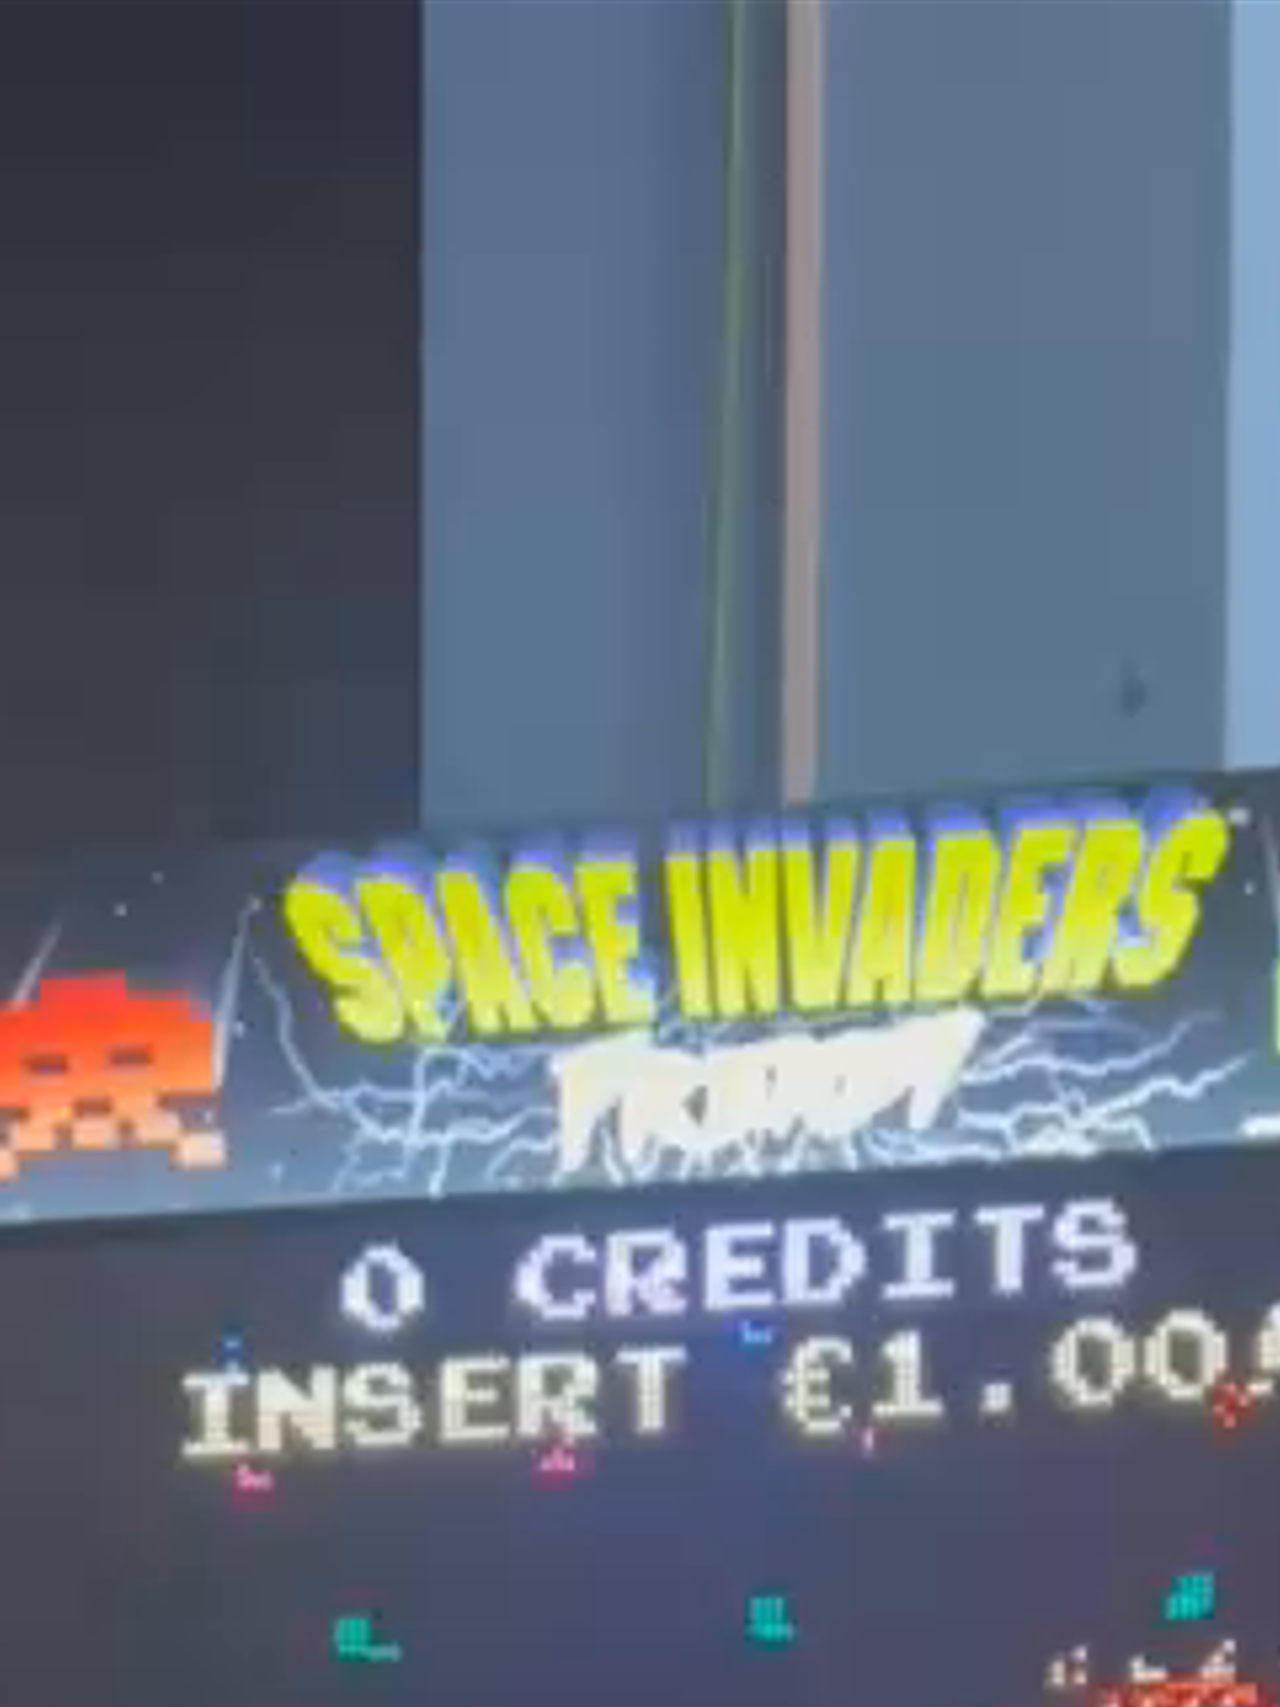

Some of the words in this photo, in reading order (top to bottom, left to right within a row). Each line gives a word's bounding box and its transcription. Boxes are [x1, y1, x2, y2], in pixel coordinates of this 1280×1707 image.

[285, 848, 656, 1044] SPACE
[666, 800, 1228, 1020] INVADERS
[512, 1197, 1140, 1322] CREDITS
[181, 1345, 688, 1460] INSERT
